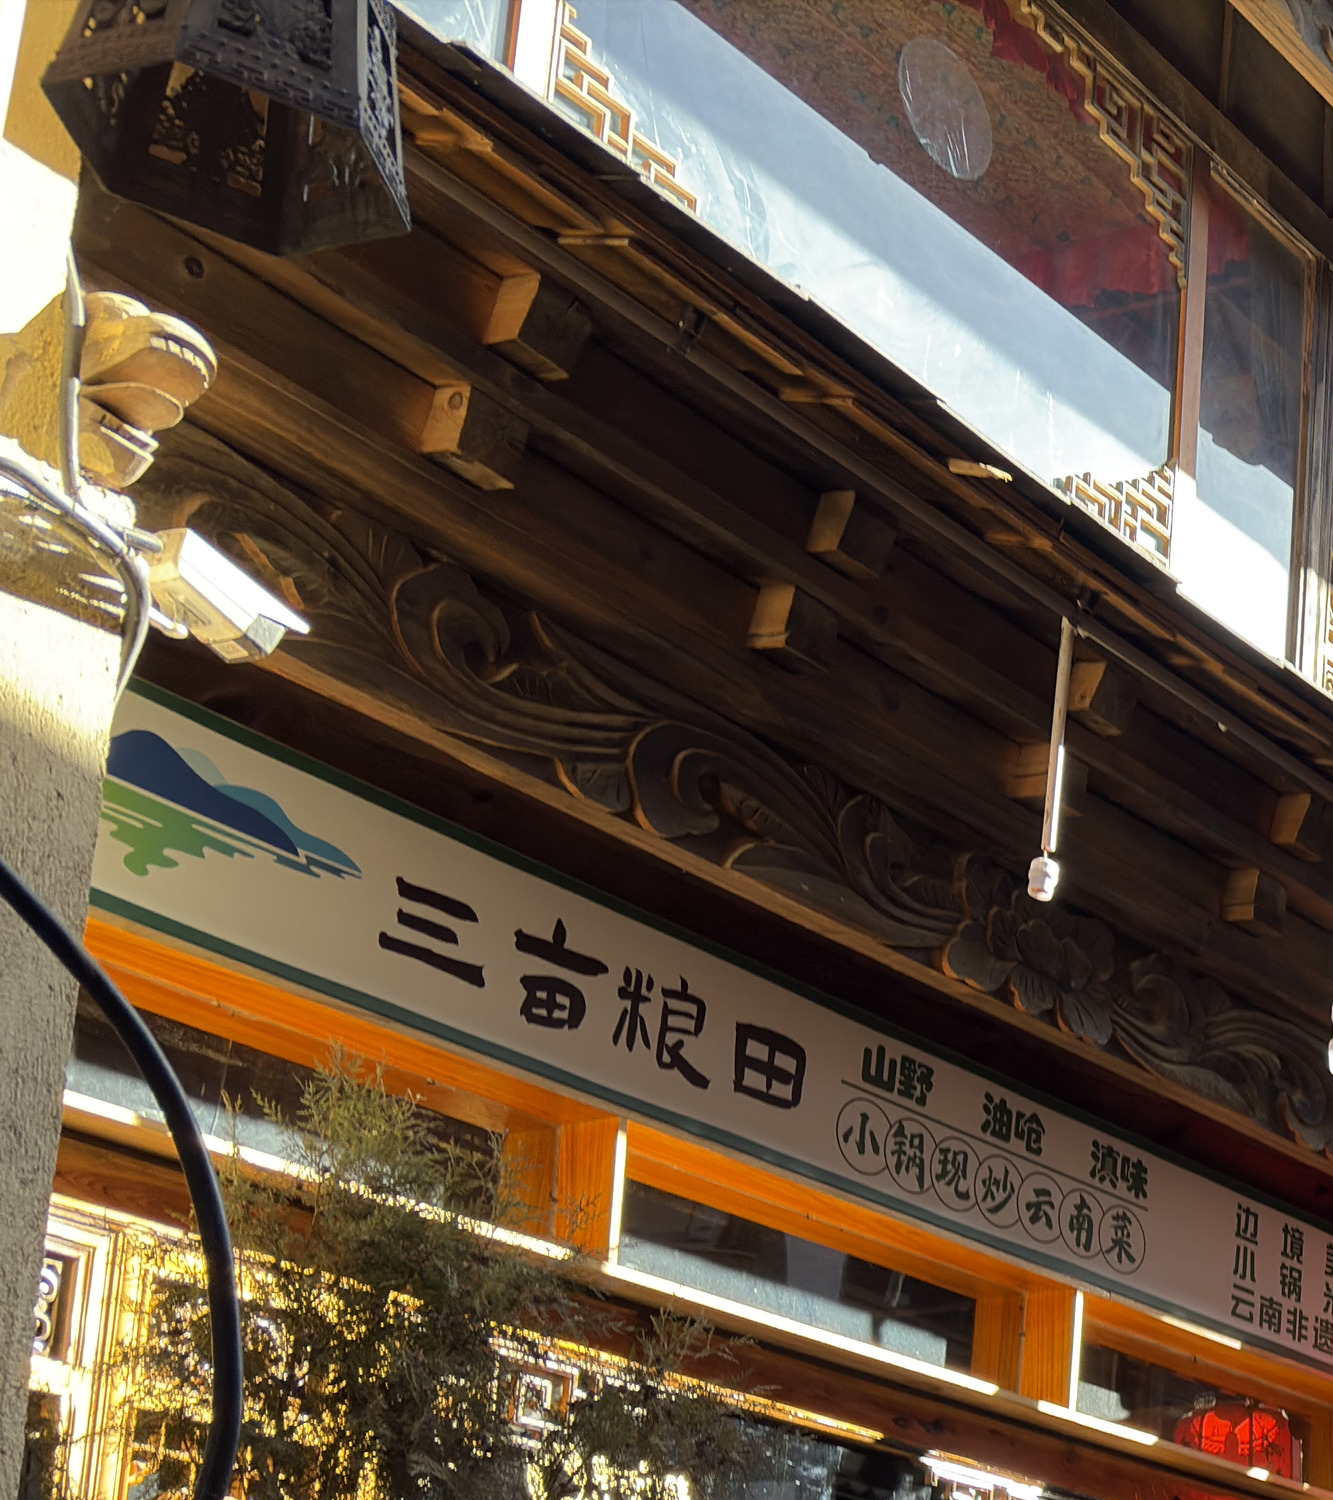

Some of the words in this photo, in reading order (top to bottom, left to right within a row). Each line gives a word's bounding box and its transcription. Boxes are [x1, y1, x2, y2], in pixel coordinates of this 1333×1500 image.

[379, 876, 807, 1109] 三亩粮田
[841, 1112, 1142, 1268] 小锅现炒云南菜
[861, 1044, 934, 1107] 山野
[981, 1091, 1045, 1156] 油呛
[1090, 1139, 1148, 1199] 滇味
